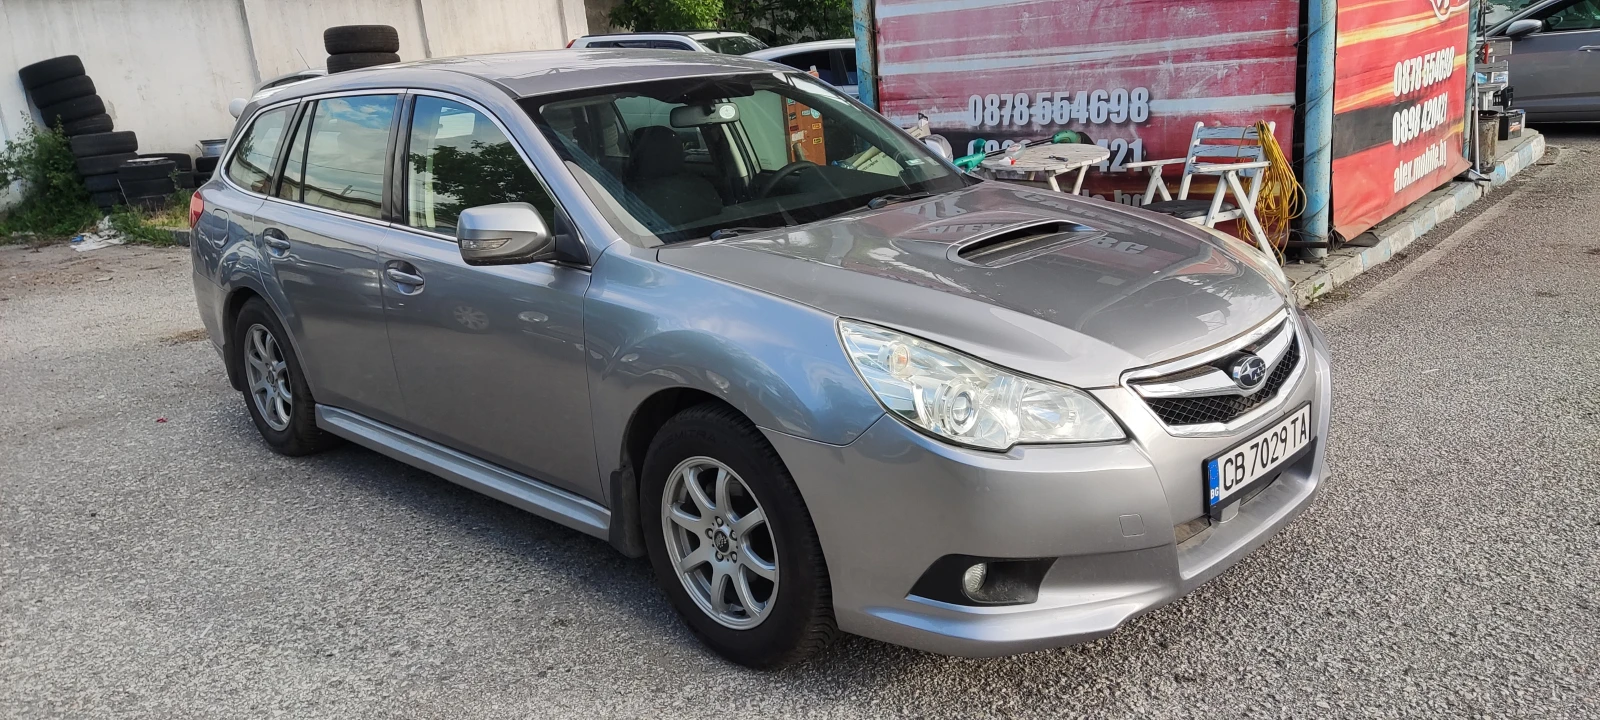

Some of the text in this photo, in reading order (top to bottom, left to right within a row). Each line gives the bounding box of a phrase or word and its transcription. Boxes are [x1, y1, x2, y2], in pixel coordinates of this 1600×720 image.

[1394, 46, 1455, 97] 0878 554698
[968, 87, 1149, 126] 0878 554698
[1392, 91, 1449, 147] 0898 420421
[1393, 139, 1447, 194] alex.mobile.bg
[1224, 413, 1307, 490] CB 7029 TA
[1210, 486, 1219, 500] BG
